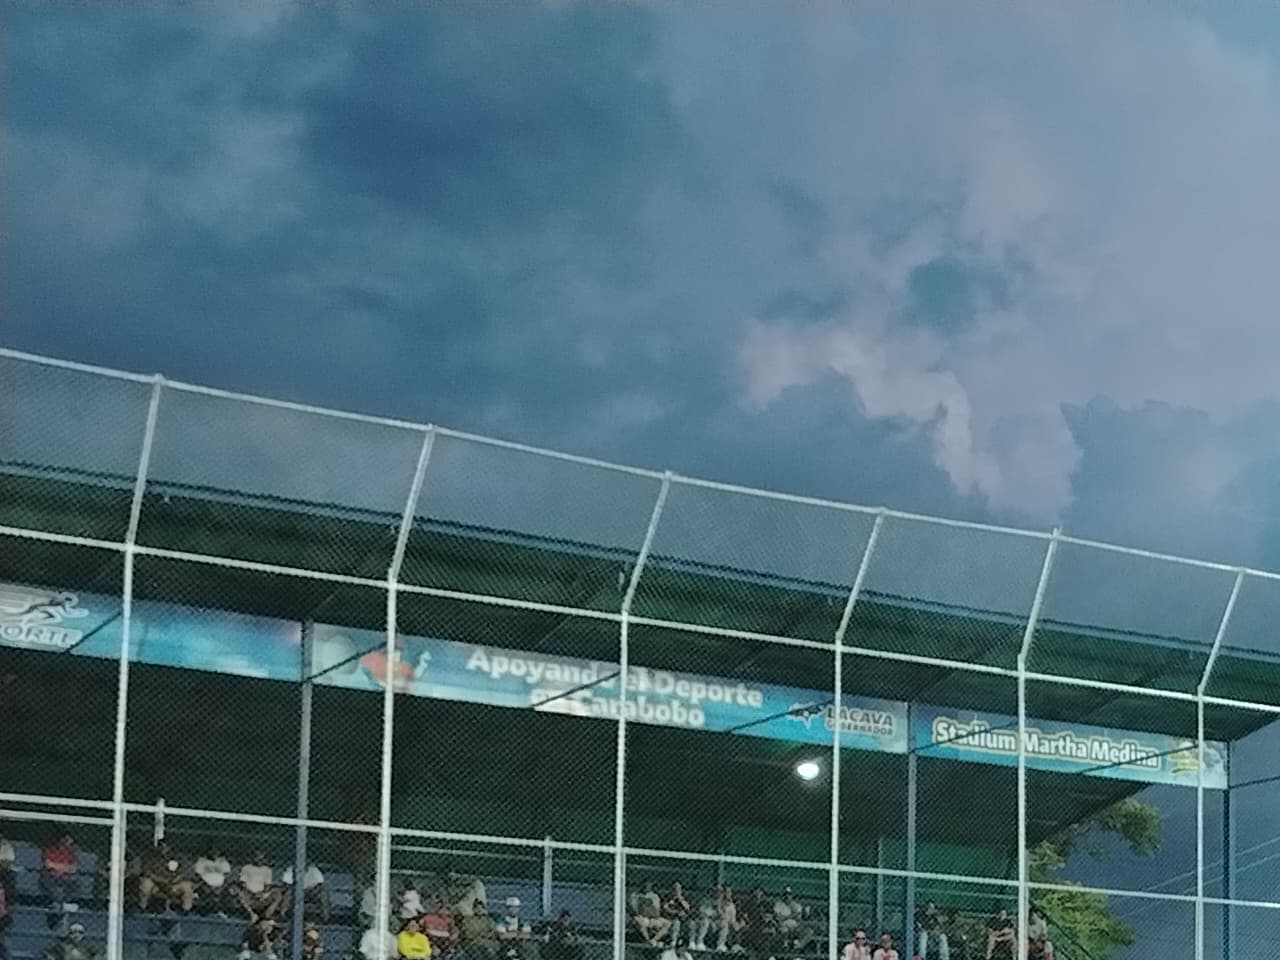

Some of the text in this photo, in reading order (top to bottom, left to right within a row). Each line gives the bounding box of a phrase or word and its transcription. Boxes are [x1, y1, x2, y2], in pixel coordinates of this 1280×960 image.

[654, 671, 763, 708] Deporte
[826, 718, 894, 737] GBERNADOR
[937, 721, 1017, 751] Stadium
[1023, 732, 1089, 758] Martha
[1091, 743, 1159, 768] Medina
